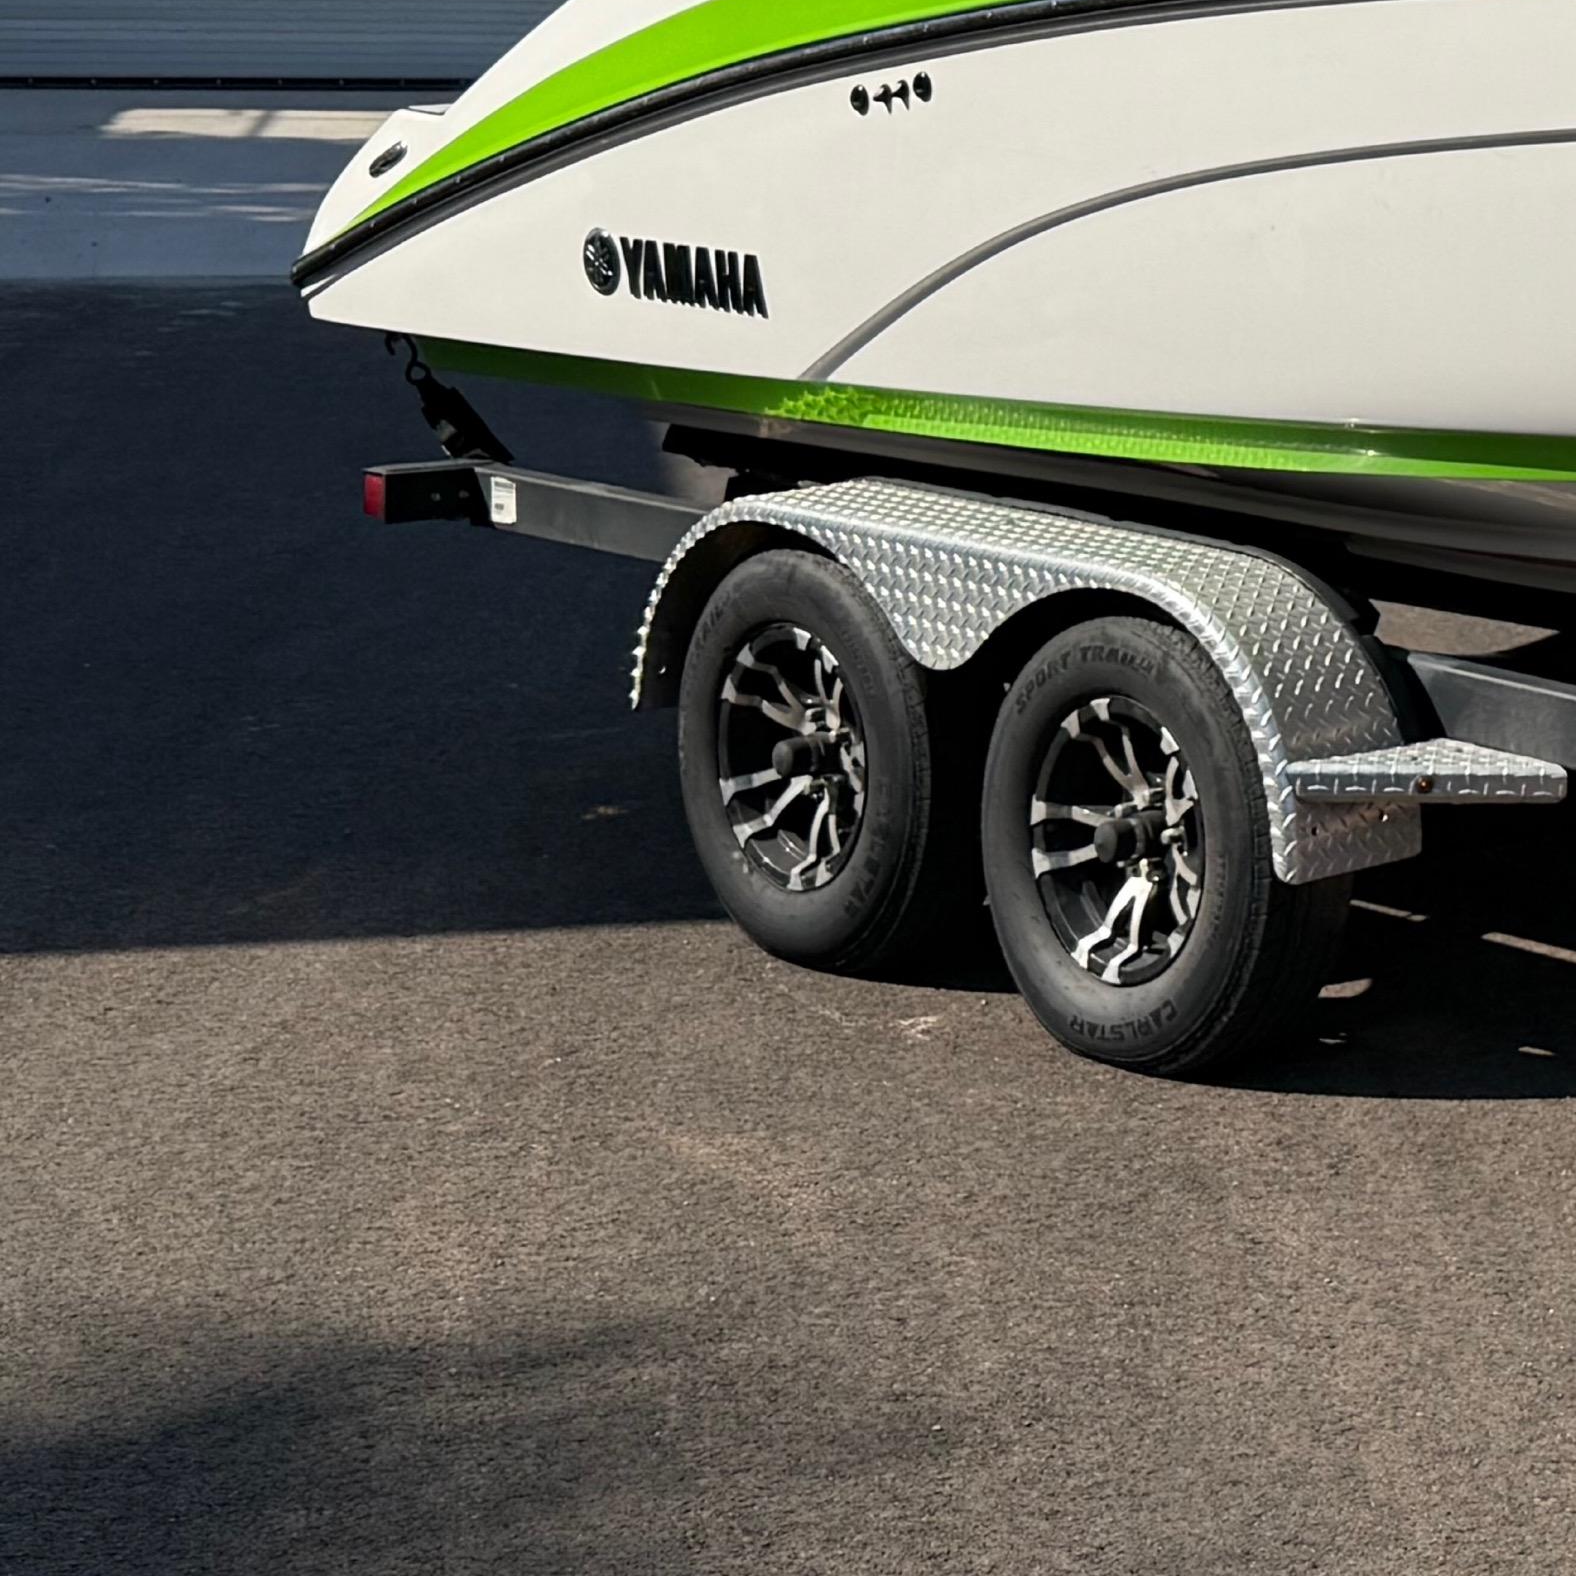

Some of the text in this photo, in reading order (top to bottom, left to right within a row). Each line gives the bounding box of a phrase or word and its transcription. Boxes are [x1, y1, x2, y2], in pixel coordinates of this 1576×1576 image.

[619, 236, 769, 319] YAMAHA
[1015, 649, 1072, 715] SPORT
[1068, 1000, 1178, 1042] CARLSTAR
